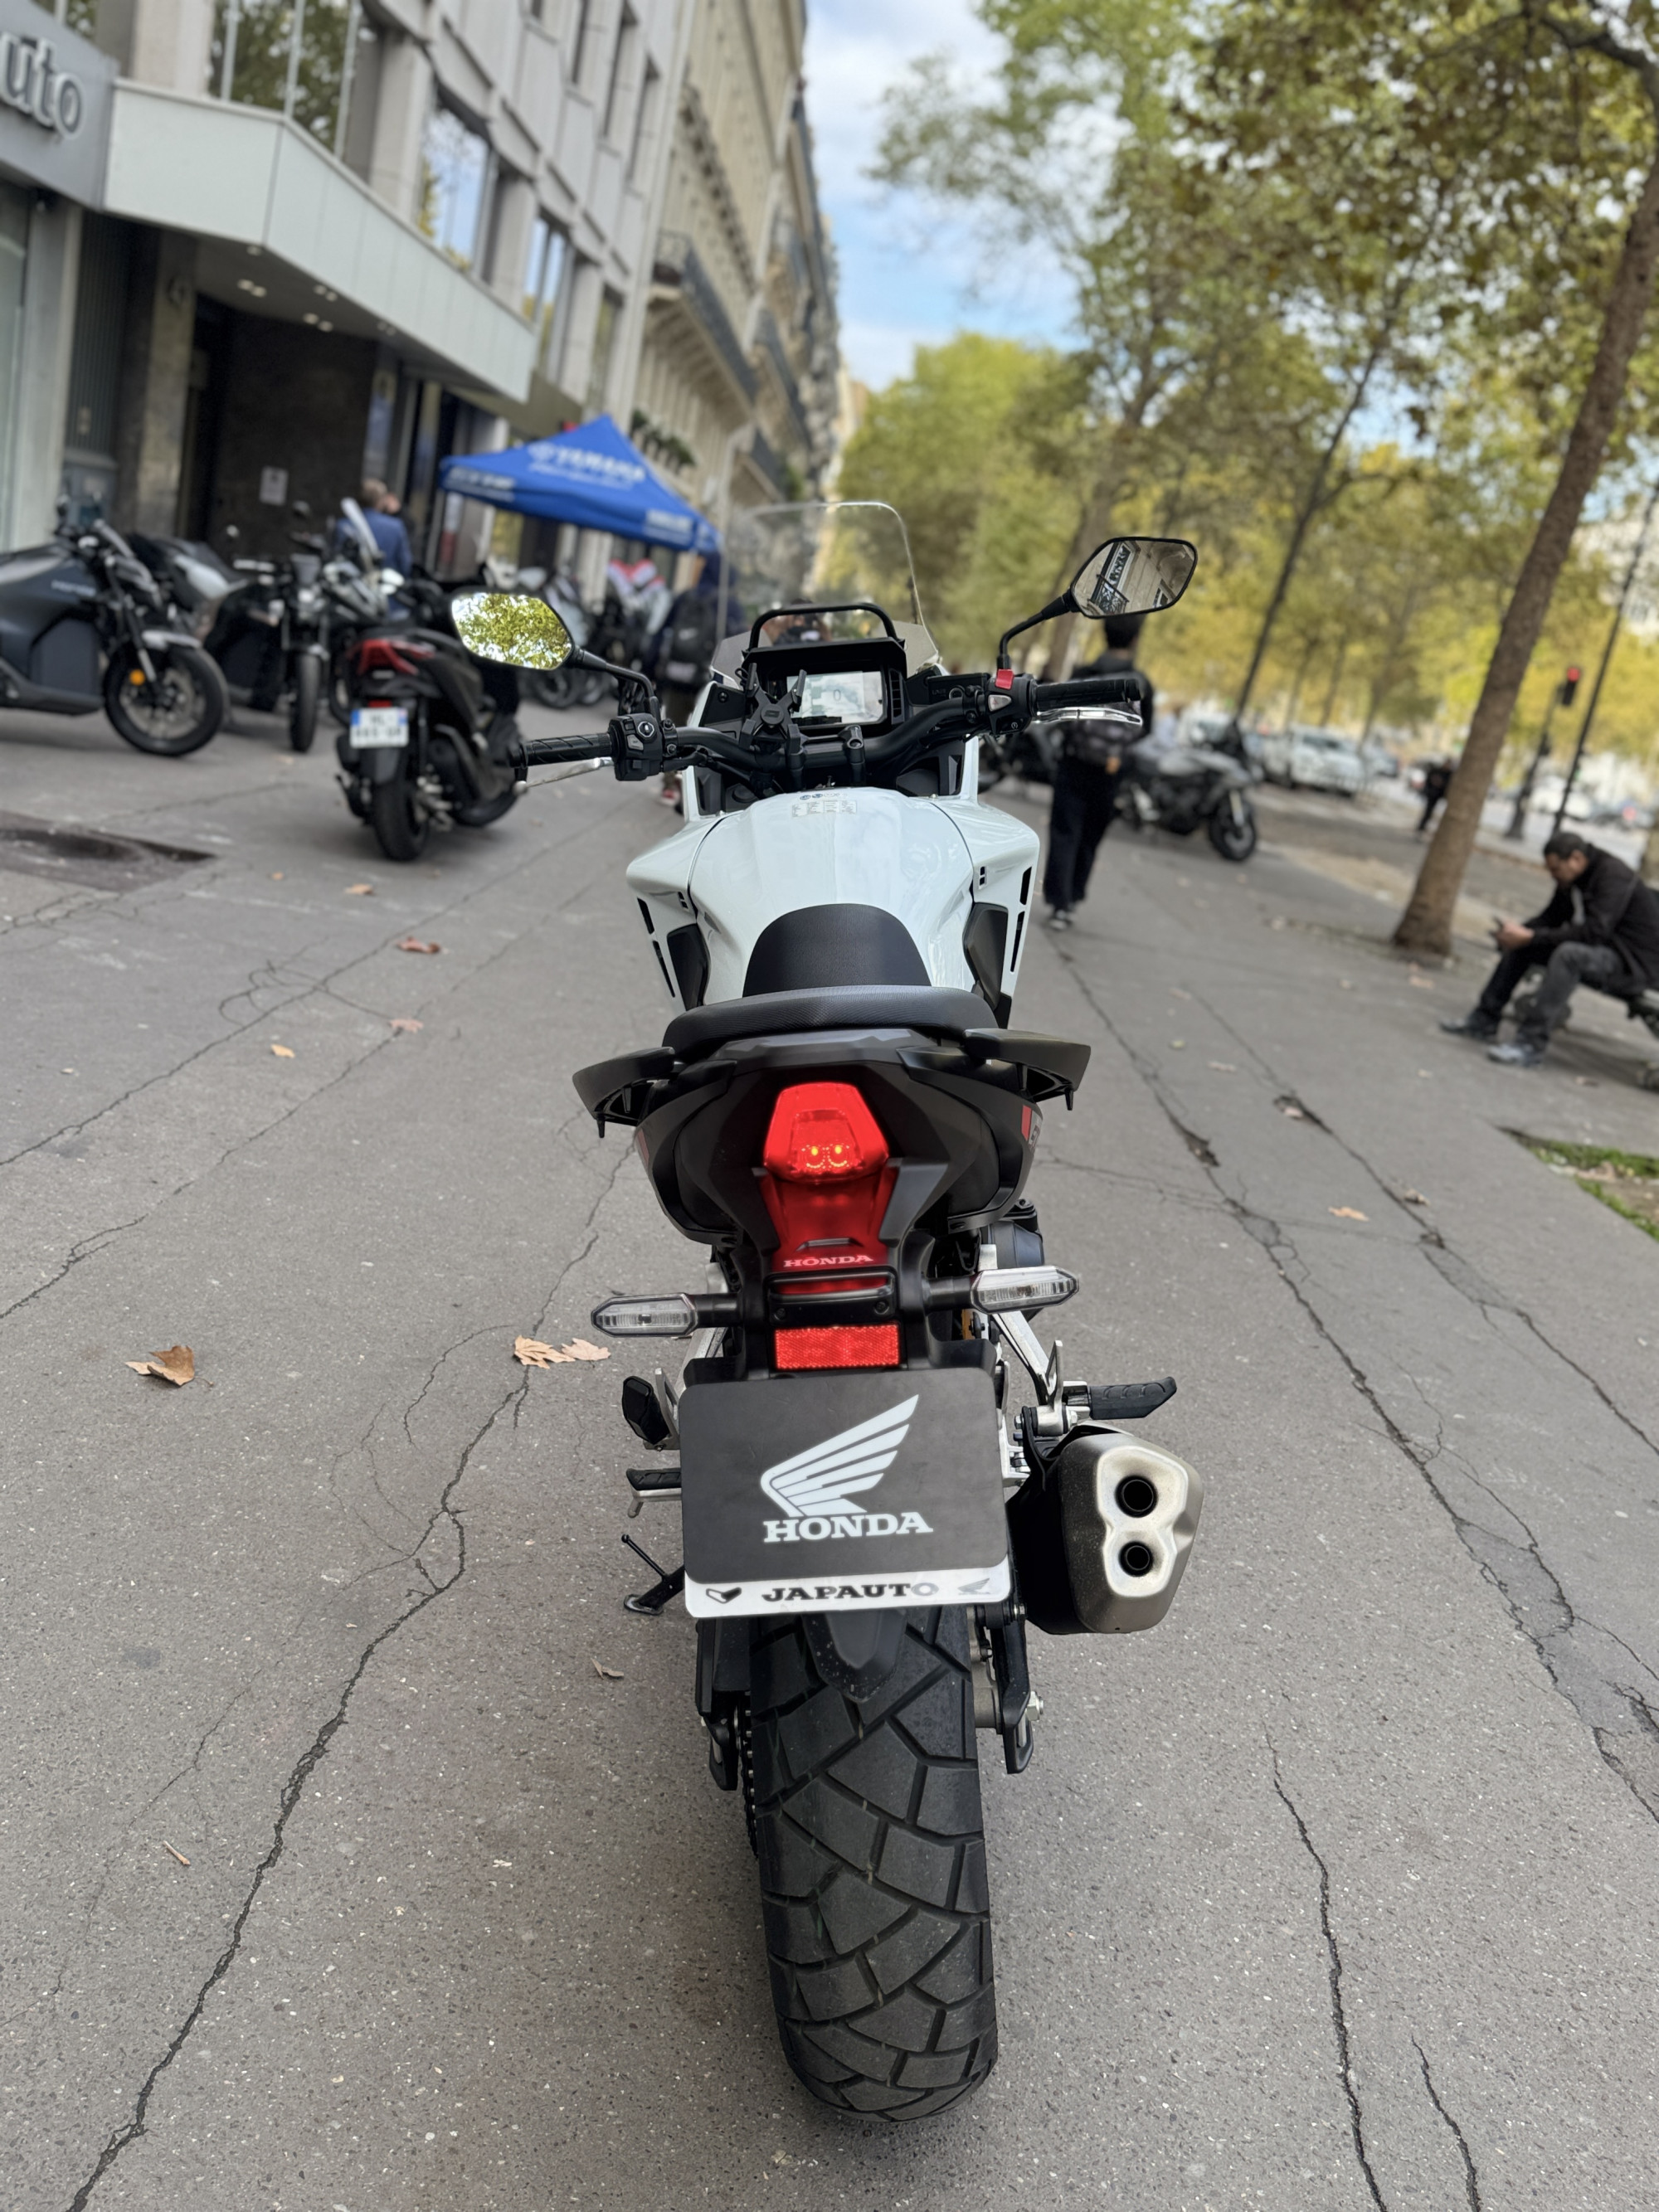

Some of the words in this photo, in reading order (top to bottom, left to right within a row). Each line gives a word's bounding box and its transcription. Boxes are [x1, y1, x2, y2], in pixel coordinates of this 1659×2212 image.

[783, 1254, 874, 1267] HONDA
[763, 1511, 934, 1543] HONDA
[761, 1582, 939, 1602] JAPAUTO
